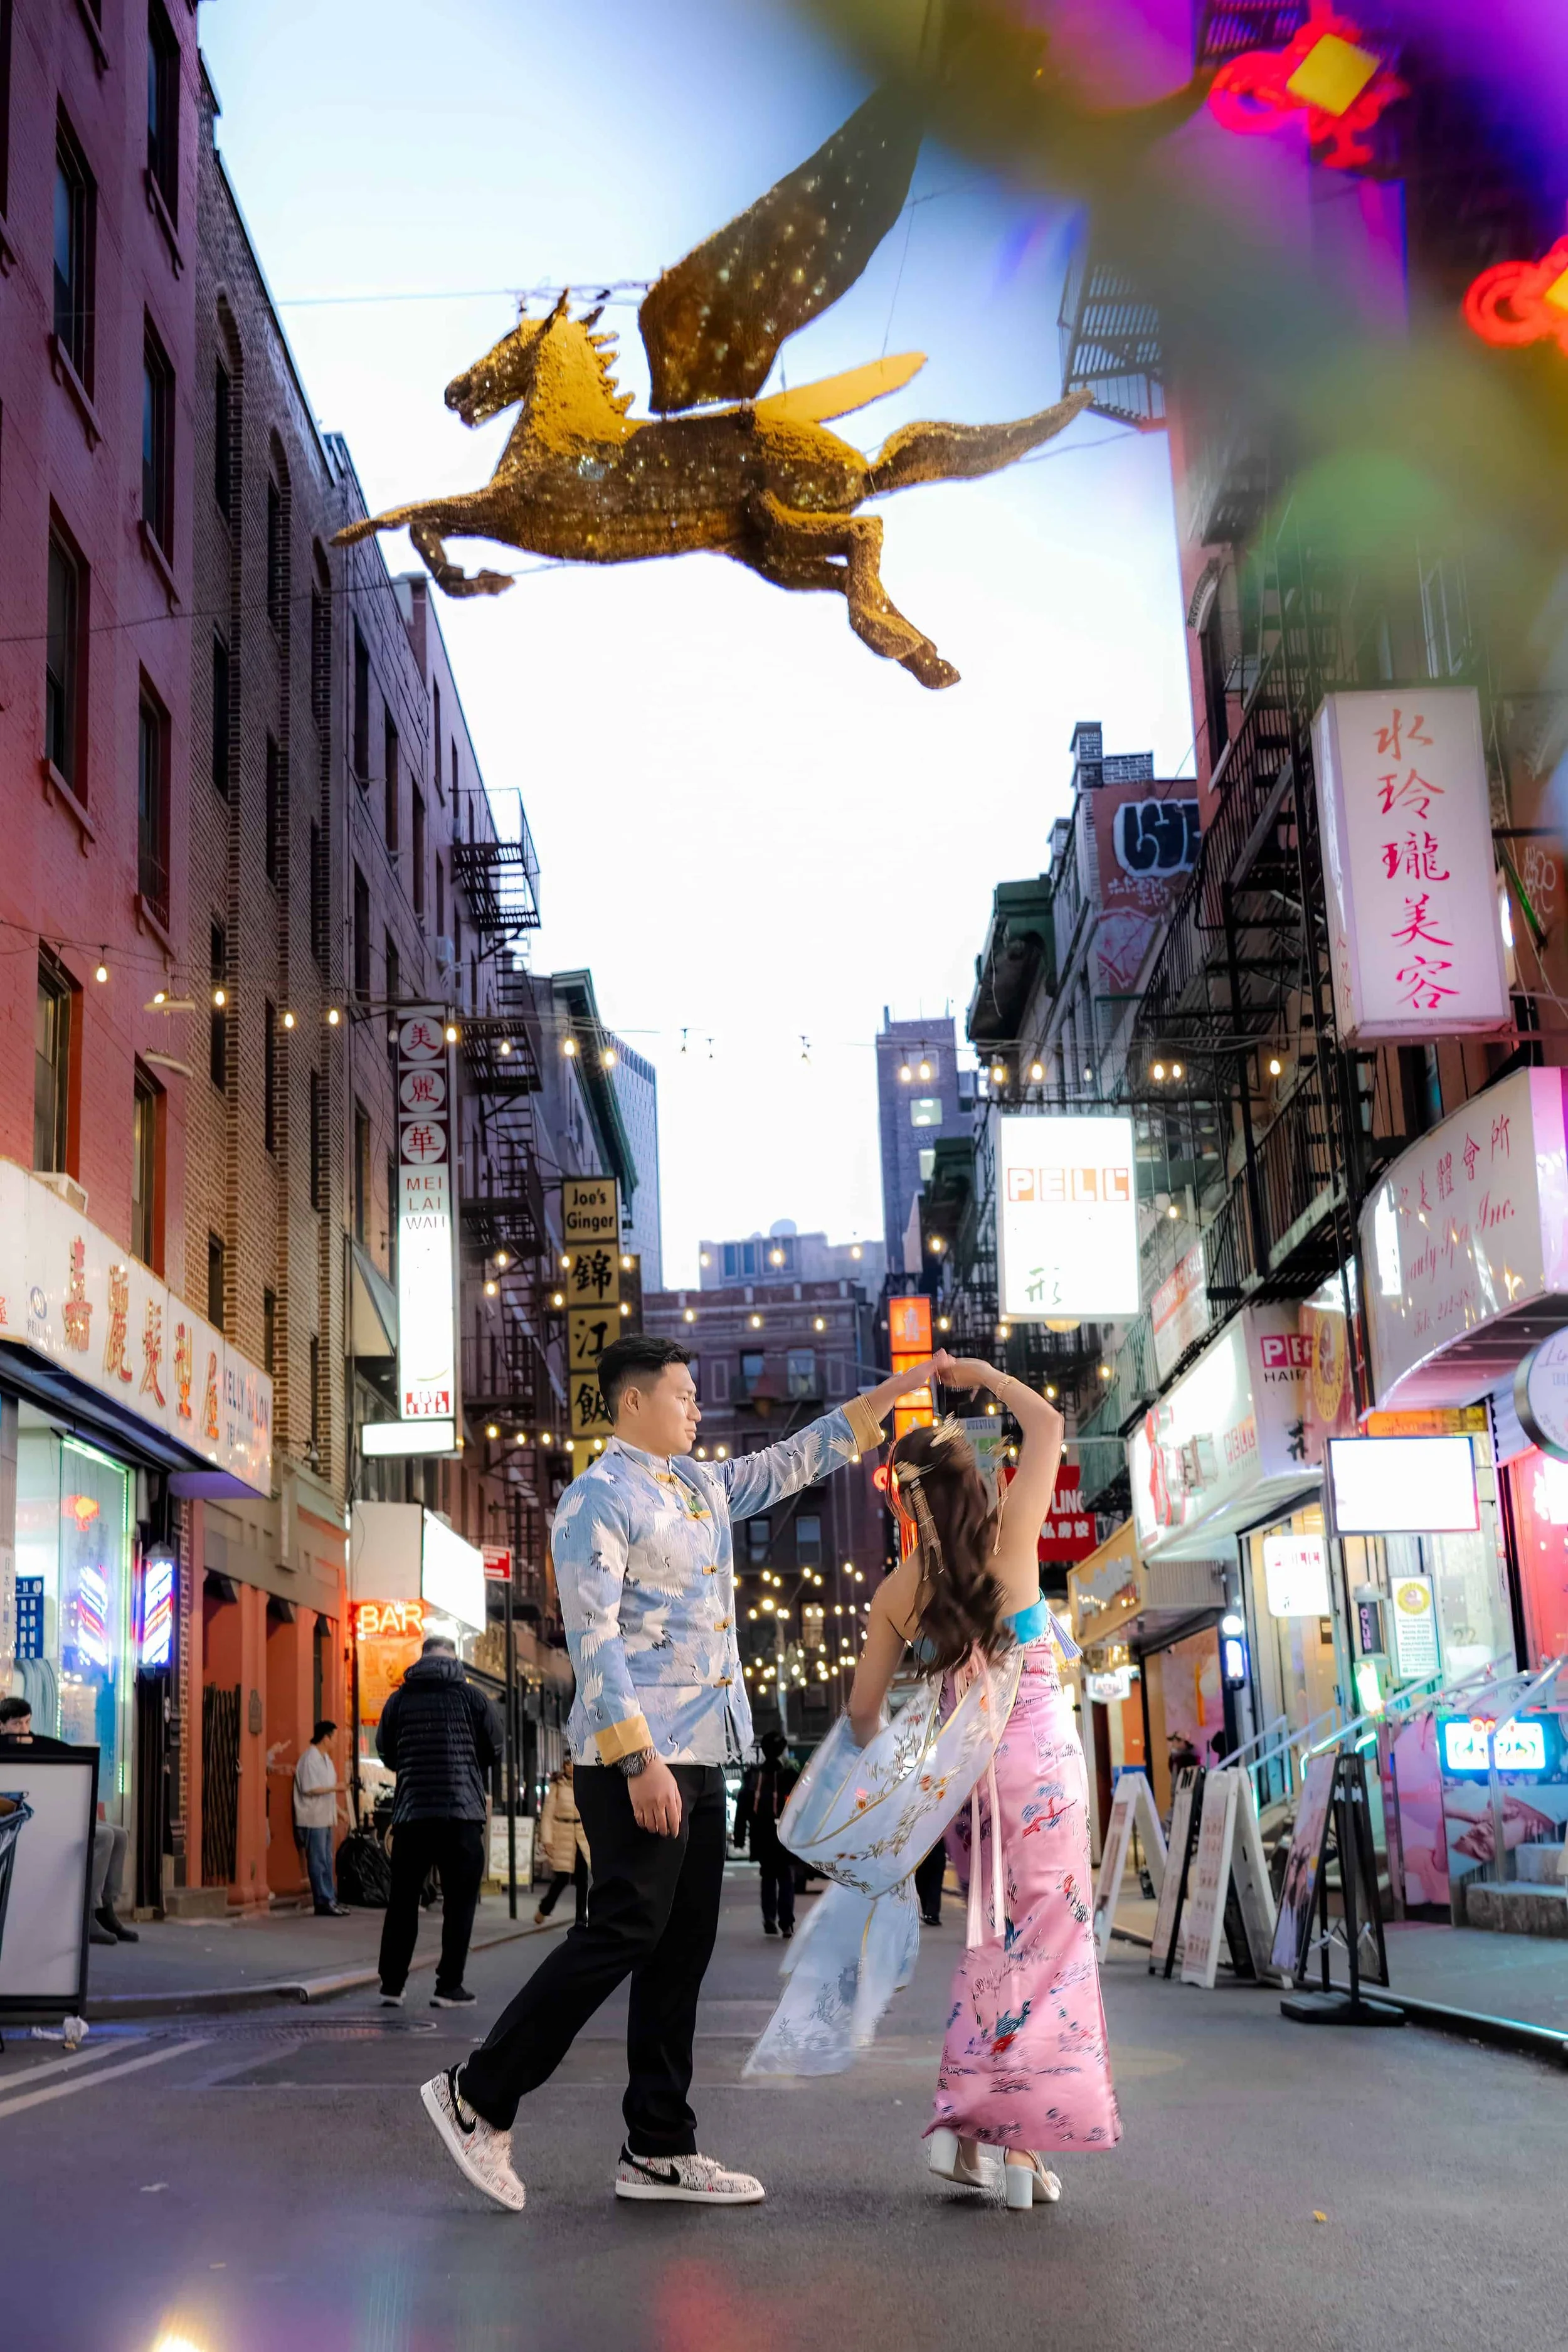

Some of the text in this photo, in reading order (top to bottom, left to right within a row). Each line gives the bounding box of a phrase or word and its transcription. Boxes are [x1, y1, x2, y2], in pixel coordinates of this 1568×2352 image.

[1375, 709, 1460, 1009] 水玲瓏美容
[406, 1176, 442, 1190] MEI
[1008, 1168, 1129, 1201] PELL
[408, 1196, 441, 1211] LAI
[573, 1187, 607, 1205] Joe's
[566, 1211, 614, 1233] Ginger
[359, 1604, 423, 1633] BAR
